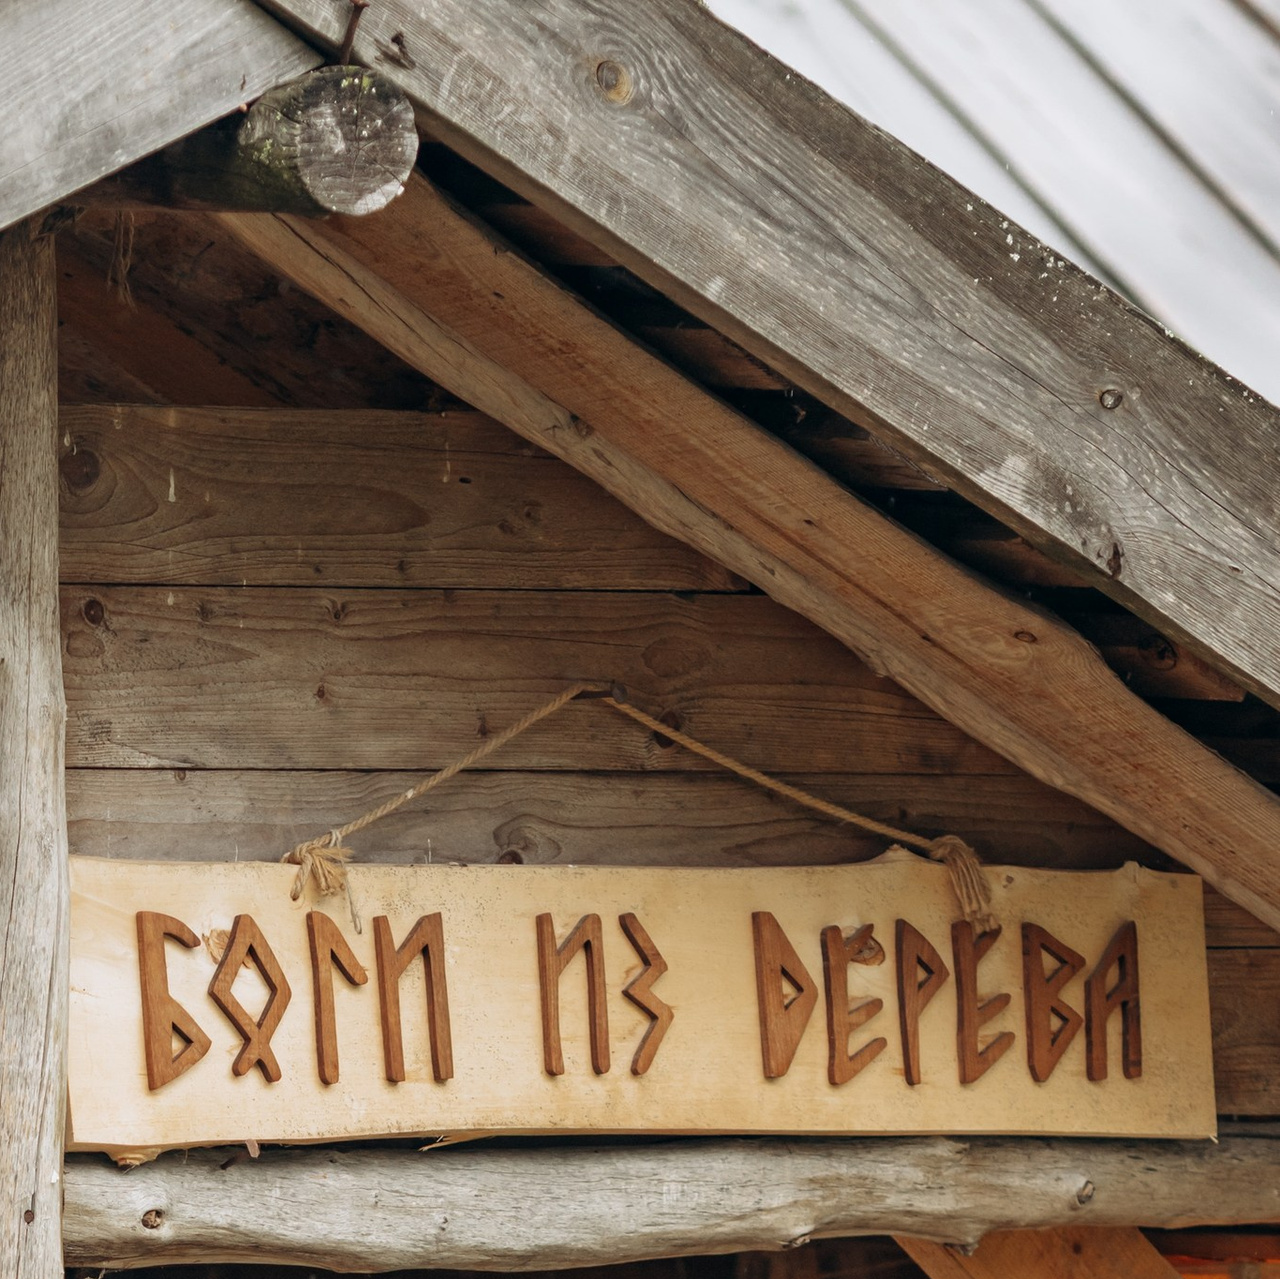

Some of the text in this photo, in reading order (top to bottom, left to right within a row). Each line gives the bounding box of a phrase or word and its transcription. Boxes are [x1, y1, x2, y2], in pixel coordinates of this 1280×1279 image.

[136, 910, 1142, 1092] БОГИ ИЗ ДЕРЕВА
